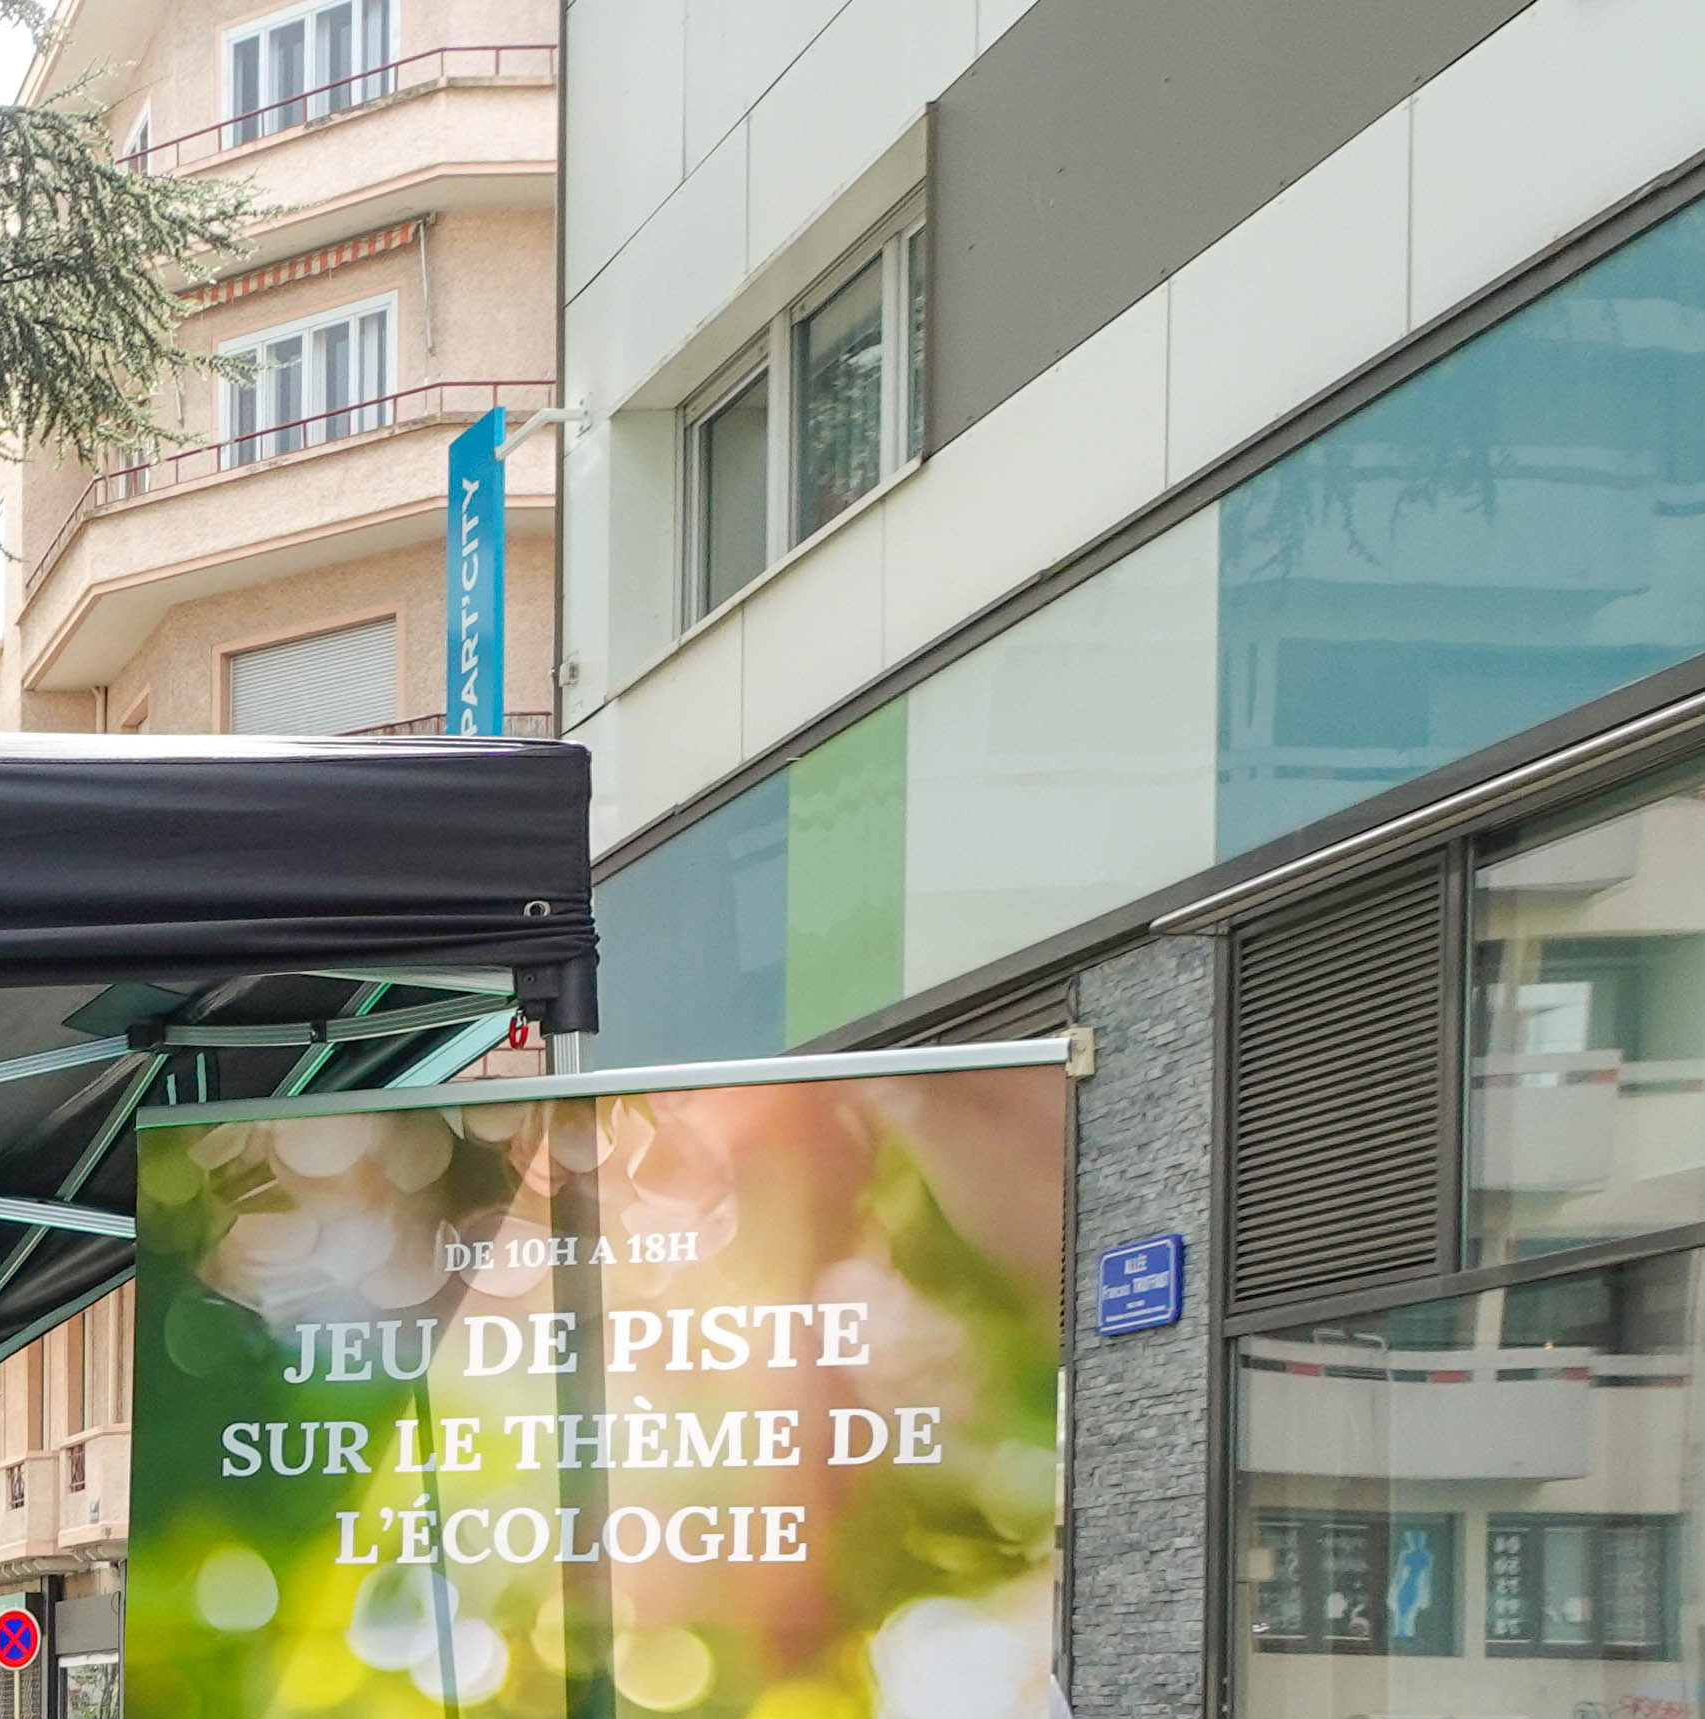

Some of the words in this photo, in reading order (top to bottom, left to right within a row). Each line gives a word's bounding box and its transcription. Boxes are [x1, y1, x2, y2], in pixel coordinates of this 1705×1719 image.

[444, 1240, 493, 1272] DE
[504, 1236, 578, 1269] 10H
[589, 1236, 618, 1265] A
[626, 1232, 700, 1265] 18H
[283, 1318, 439, 1384] JEU
[463, 1312, 577, 1377] DE
[607, 1302, 871, 1374] PISTE
[220, 1420, 371, 1478] SUR
[393, 1417, 483, 1474] LE
[503, 1395, 801, 1470] THÈME
[827, 1406, 943, 1466] DE
[334, 1493, 809, 1565] L'ÉCOLOGIE
